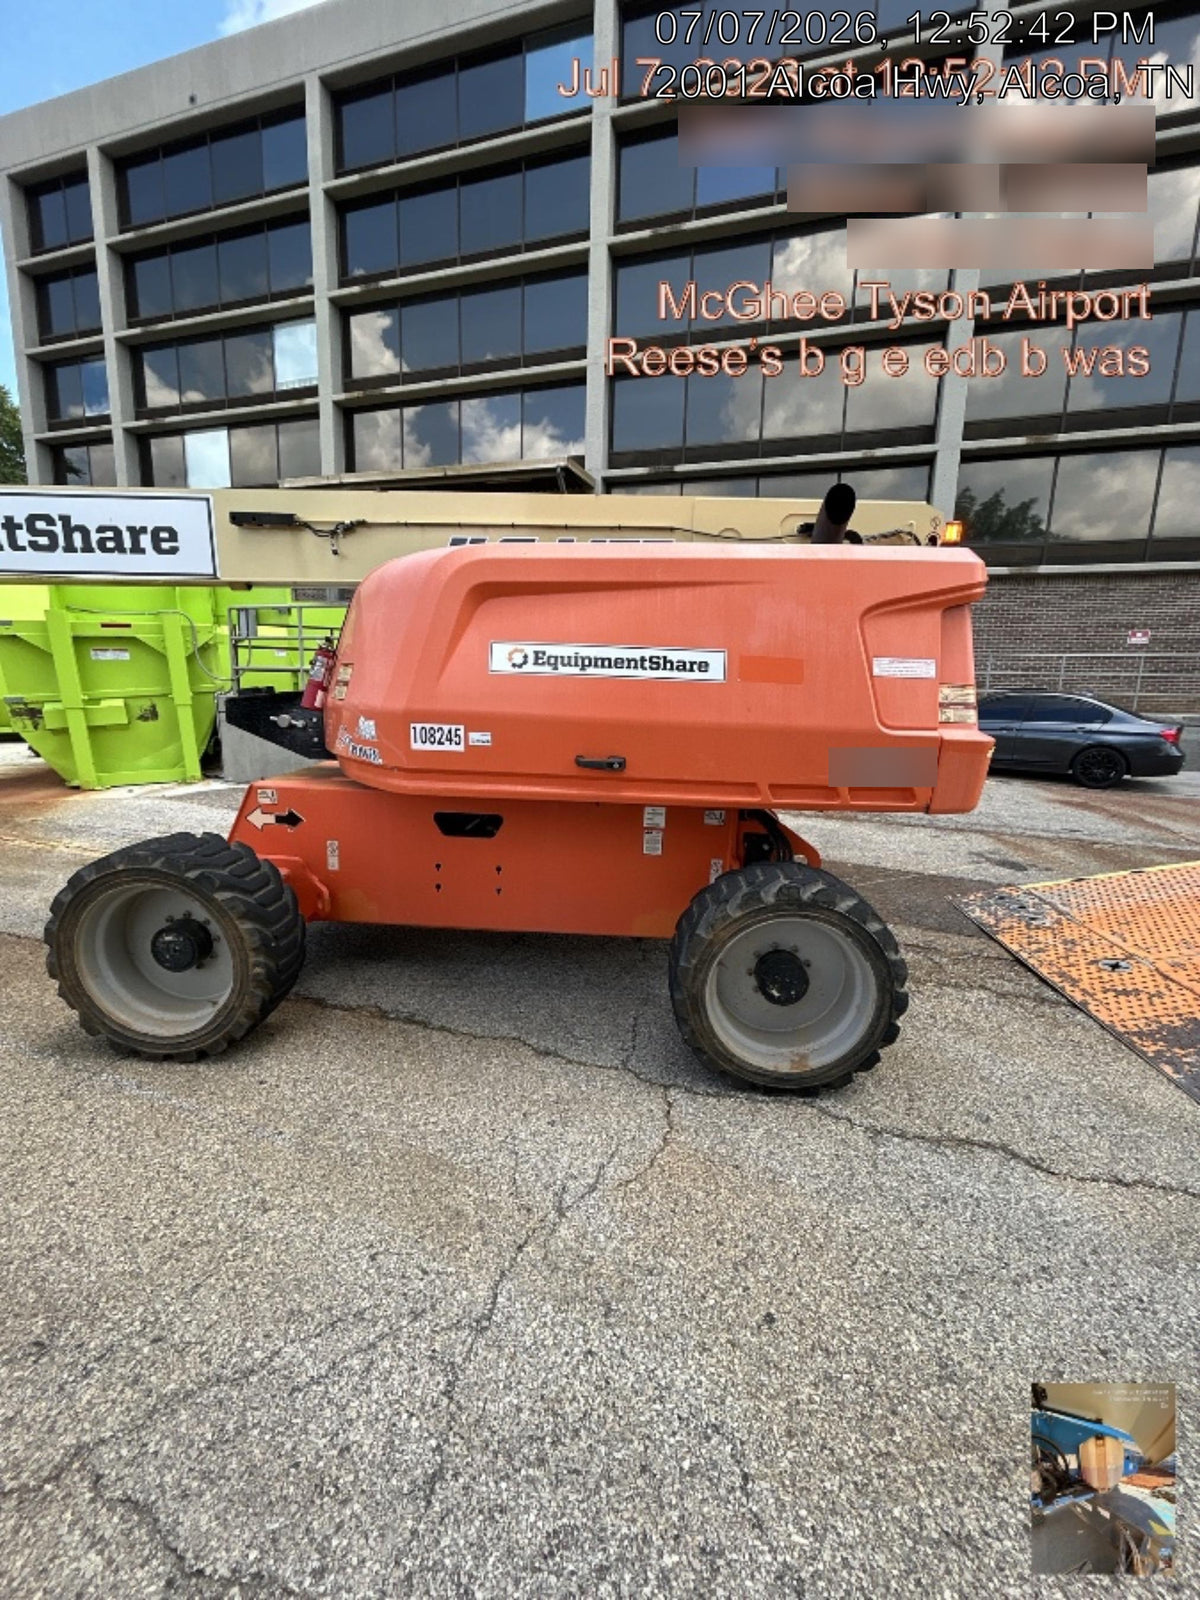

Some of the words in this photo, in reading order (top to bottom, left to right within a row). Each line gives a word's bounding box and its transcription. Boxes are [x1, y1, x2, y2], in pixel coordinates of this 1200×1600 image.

[0, 513, 180, 555] tShare
[532, 650, 711, 673] EquipmentShare
[411, 726, 462, 746] 108245
